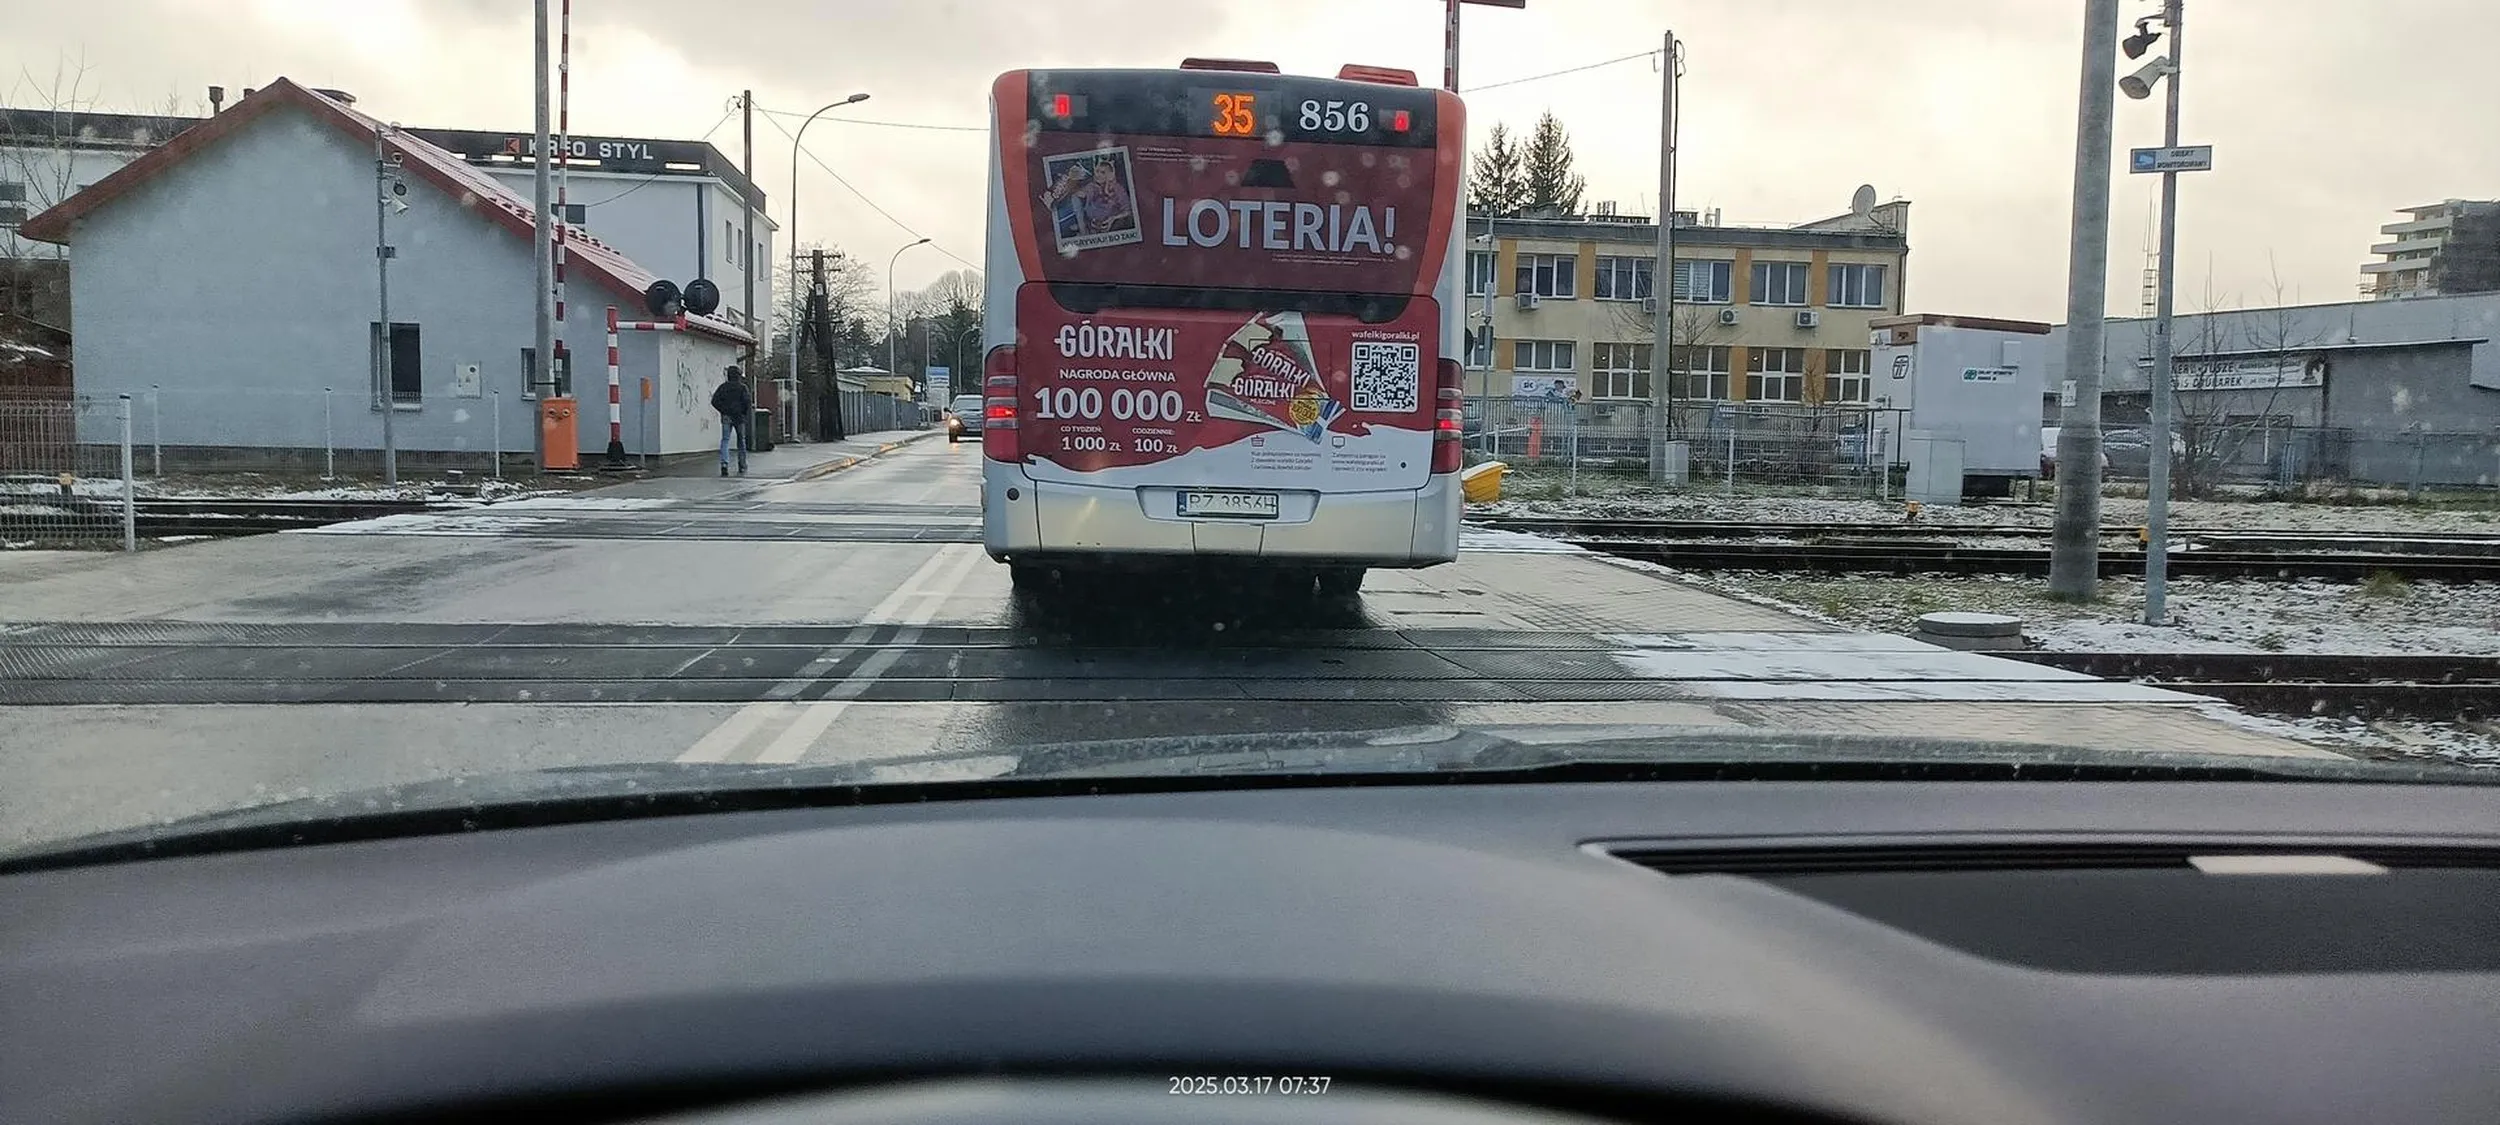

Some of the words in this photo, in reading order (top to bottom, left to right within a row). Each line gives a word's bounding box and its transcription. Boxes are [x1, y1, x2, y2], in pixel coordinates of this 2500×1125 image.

[1213, 94, 1255, 134] 35
[1300, 100, 1370, 132] 856
[600, 142, 654, 160] STYL
[1162, 197, 1396, 255] LOTERIA!
[1351, 330, 1420, 341] wafelkigoralki.pl
[1060, 368, 1121, 381] NAGRODA
[1122, 369, 1176, 383] GŁÓWNA
[1034, 387, 1103, 420] 100
[1111, 388, 1183, 422] 000
[1062, 437, 1071, 450] 1
[1074, 436, 1106, 451] 000
[1134, 438, 1163, 452] 100
